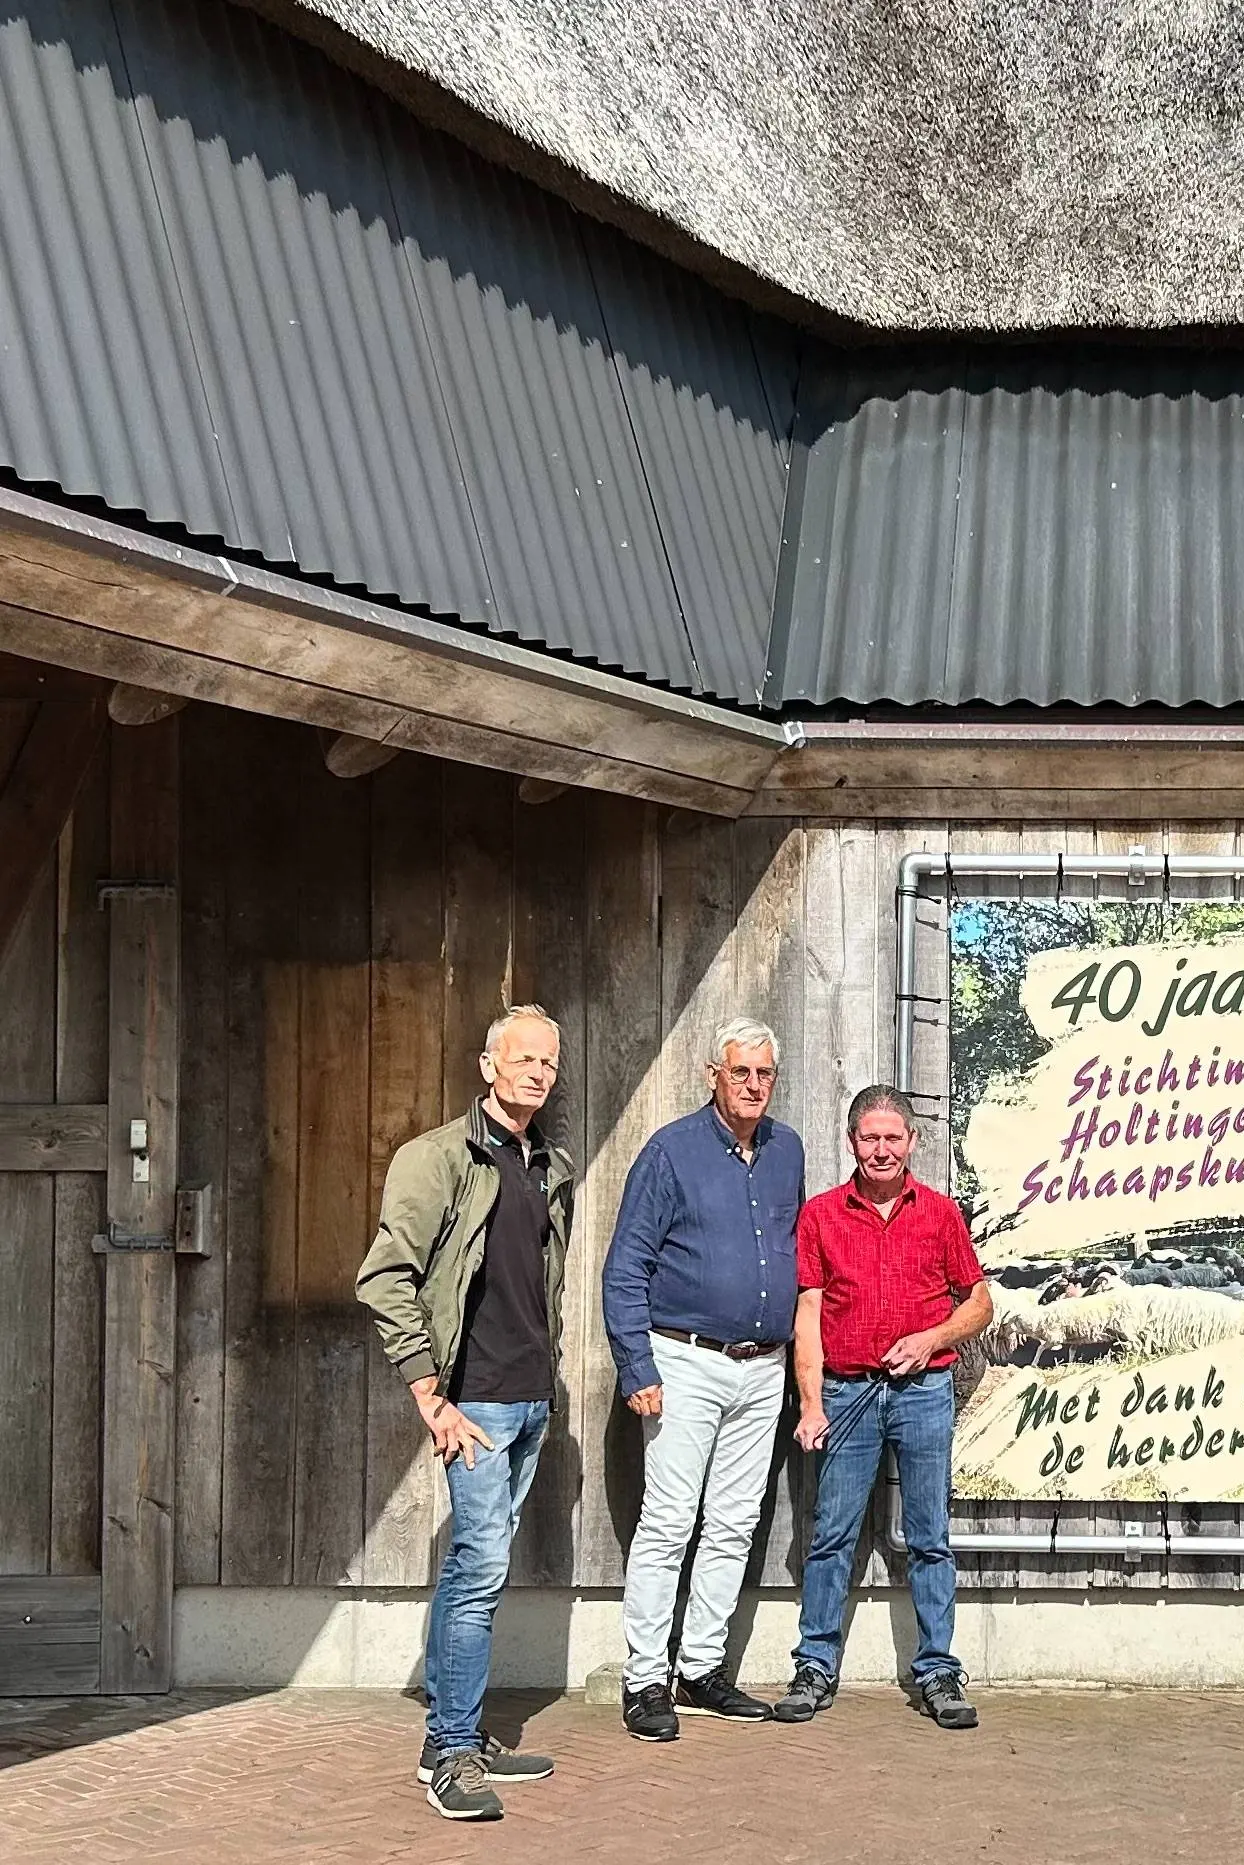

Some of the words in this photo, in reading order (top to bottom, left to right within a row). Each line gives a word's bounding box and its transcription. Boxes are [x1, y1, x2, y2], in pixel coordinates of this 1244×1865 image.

[1051, 960, 1141, 1025] 40
[1015, 1383, 1100, 1437] Met
[1121, 1365, 1224, 1417] dank
[1039, 1431, 1084, 1477] de
